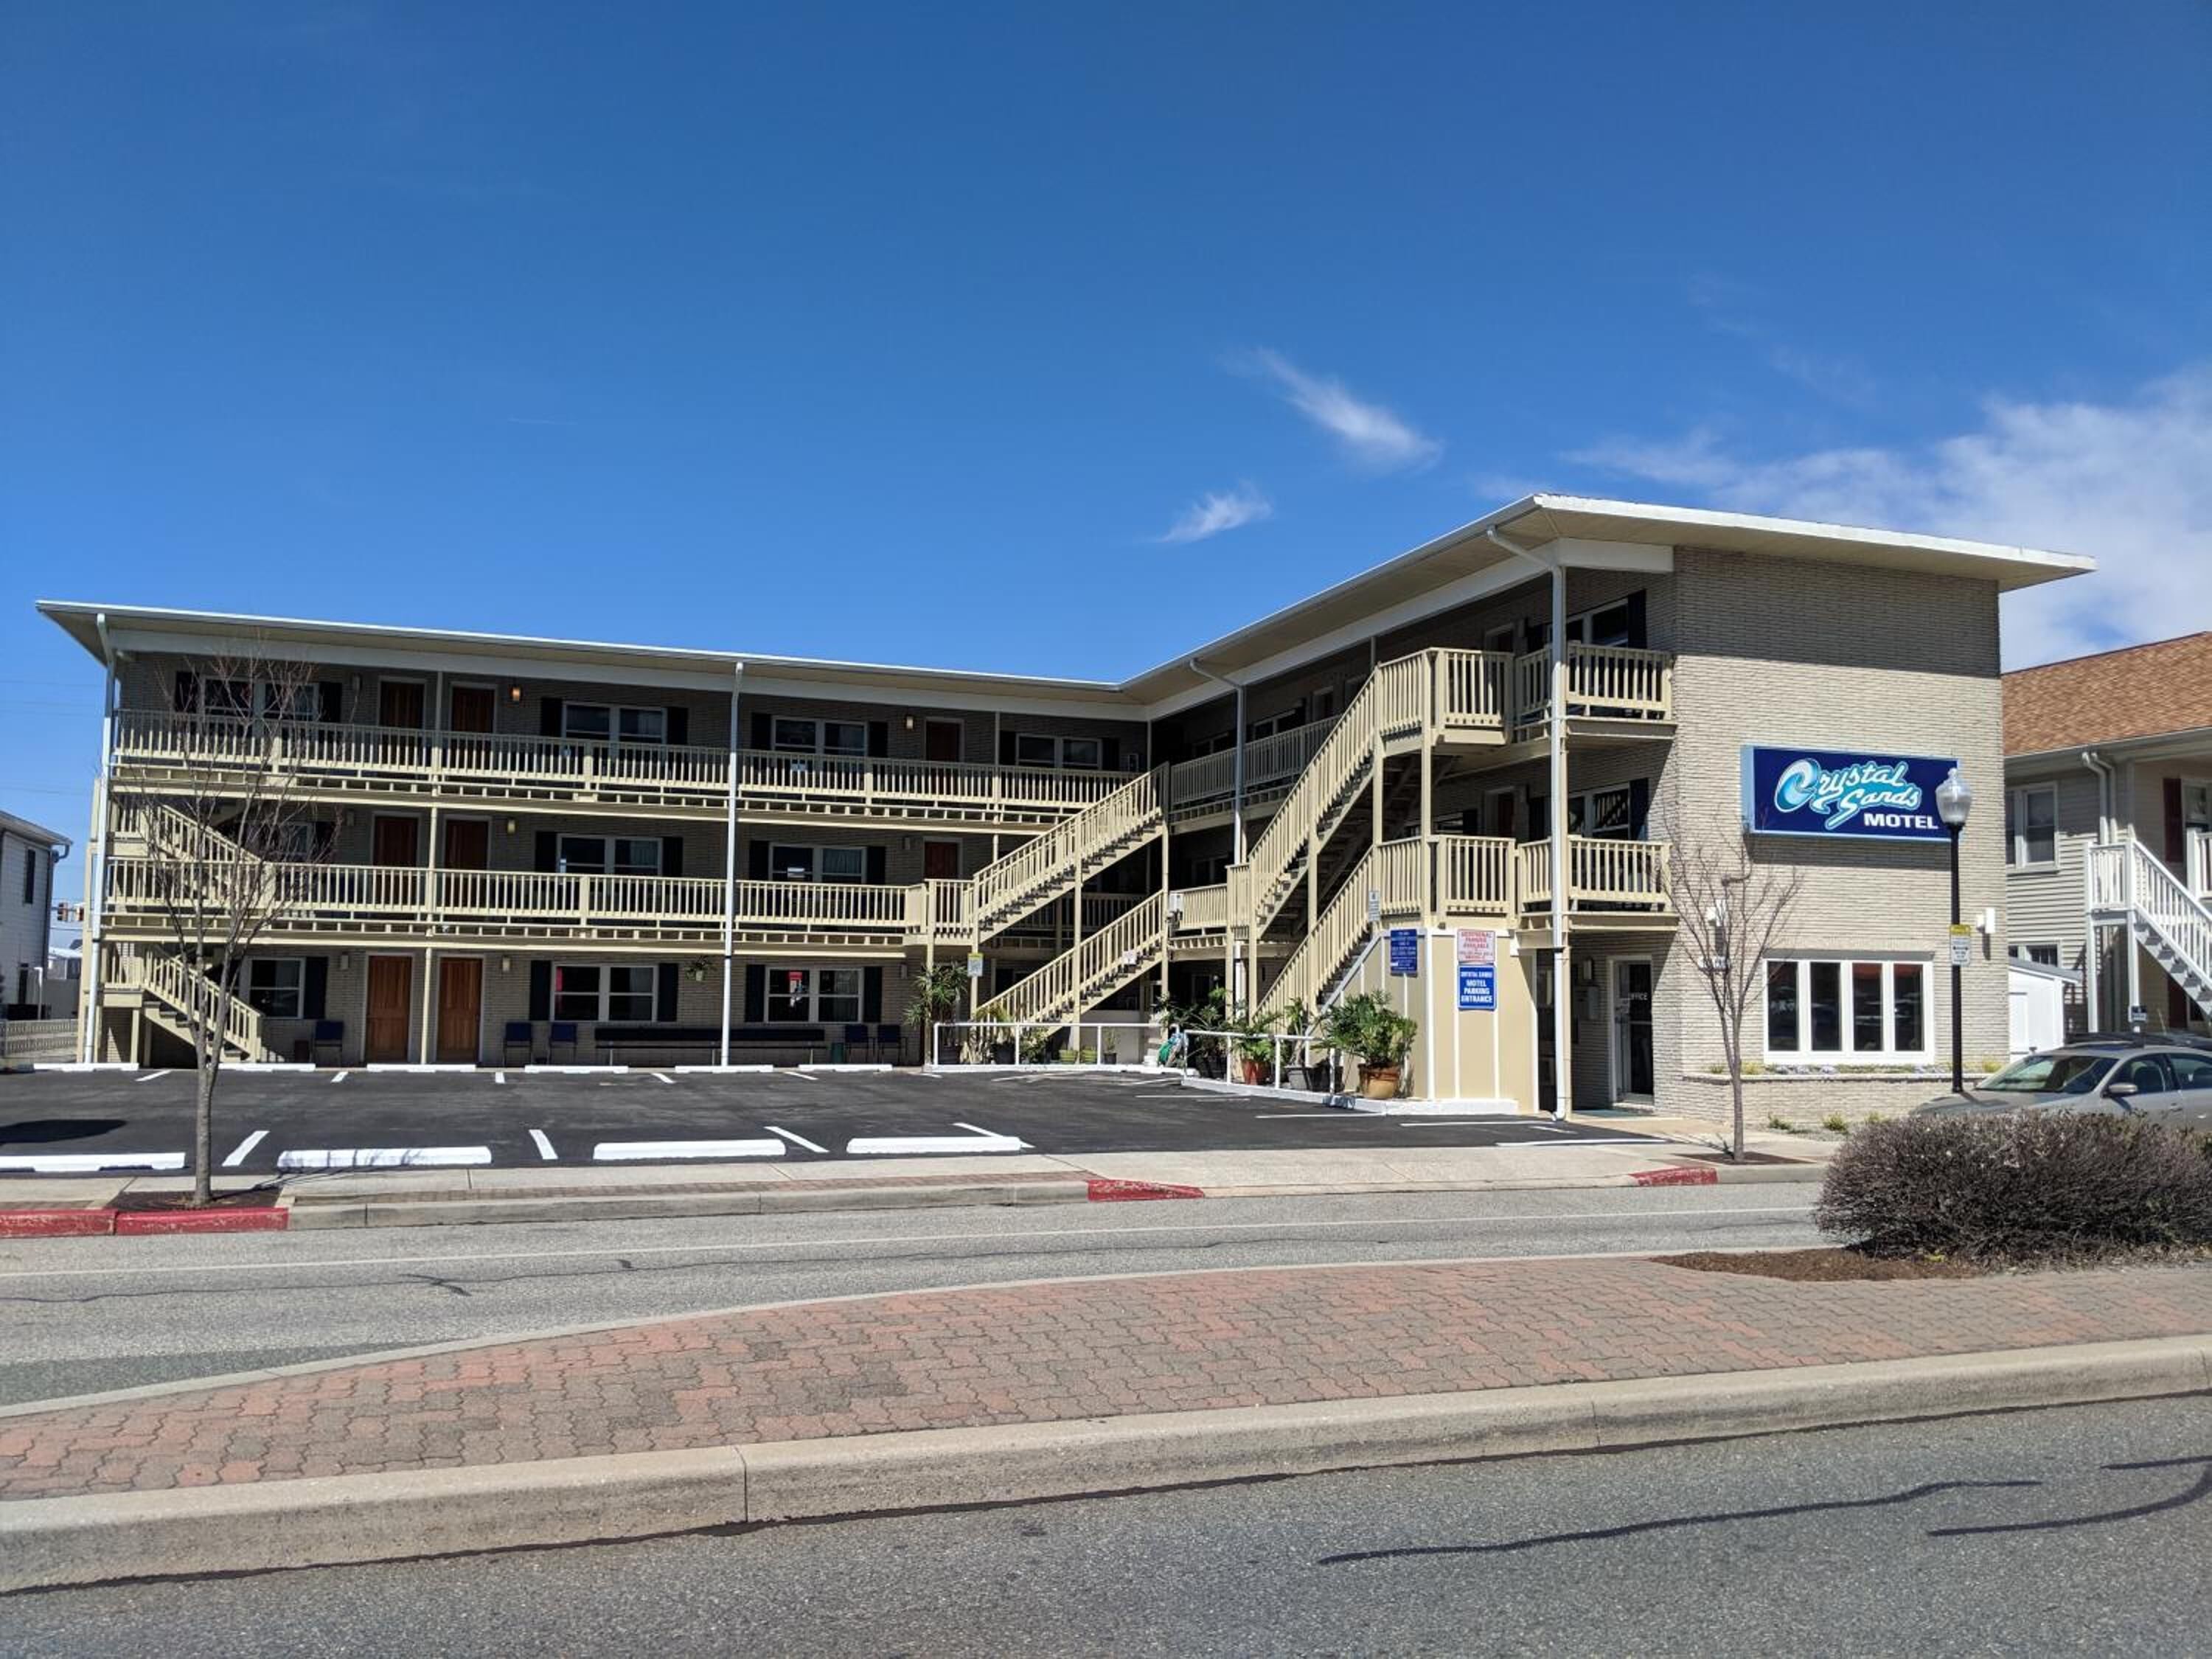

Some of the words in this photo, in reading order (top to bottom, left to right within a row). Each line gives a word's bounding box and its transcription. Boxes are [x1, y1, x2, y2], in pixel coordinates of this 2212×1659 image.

[1775, 758, 1908, 813] Crystal
[1825, 783, 1922, 830] Sands
[1864, 813, 1938, 830] MOTEL
[1461, 995, 1492, 1003] ENTRANCE
